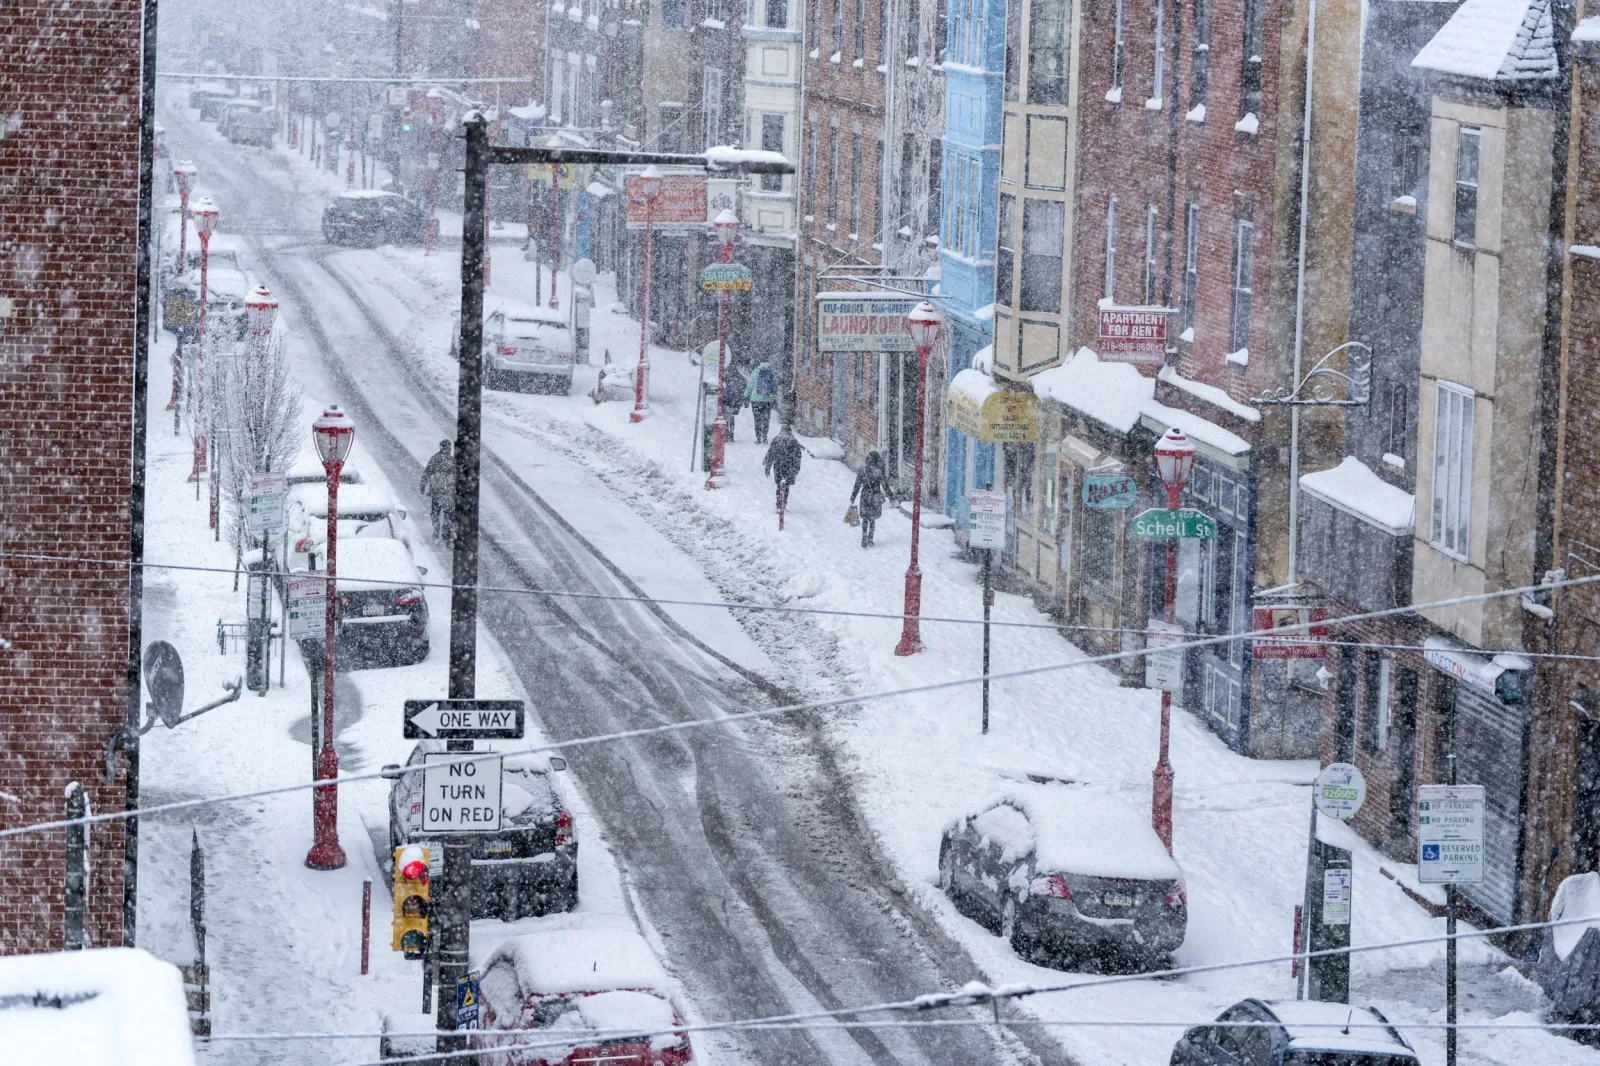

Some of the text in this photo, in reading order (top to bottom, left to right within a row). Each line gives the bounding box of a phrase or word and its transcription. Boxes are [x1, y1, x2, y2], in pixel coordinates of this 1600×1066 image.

[822, 315, 911, 335] LAUNDROMA
[1103, 313, 1164, 325] APARTMENT
[1108, 325, 1158, 337] FOR RENT
[1136, 520, 1210, 536] Schell St
[440, 712, 511, 727] ONE WAY
[449, 762, 476, 777] NO
[439, 785, 485, 799] TURN
[1322, 789, 1357, 799] 926605
[411, 805, 420, 813] NO
[429, 807, 494, 824] ON RED
[1441, 844, 1481, 852] RESERVED
[1443, 854, 1479, 862] PARKING
